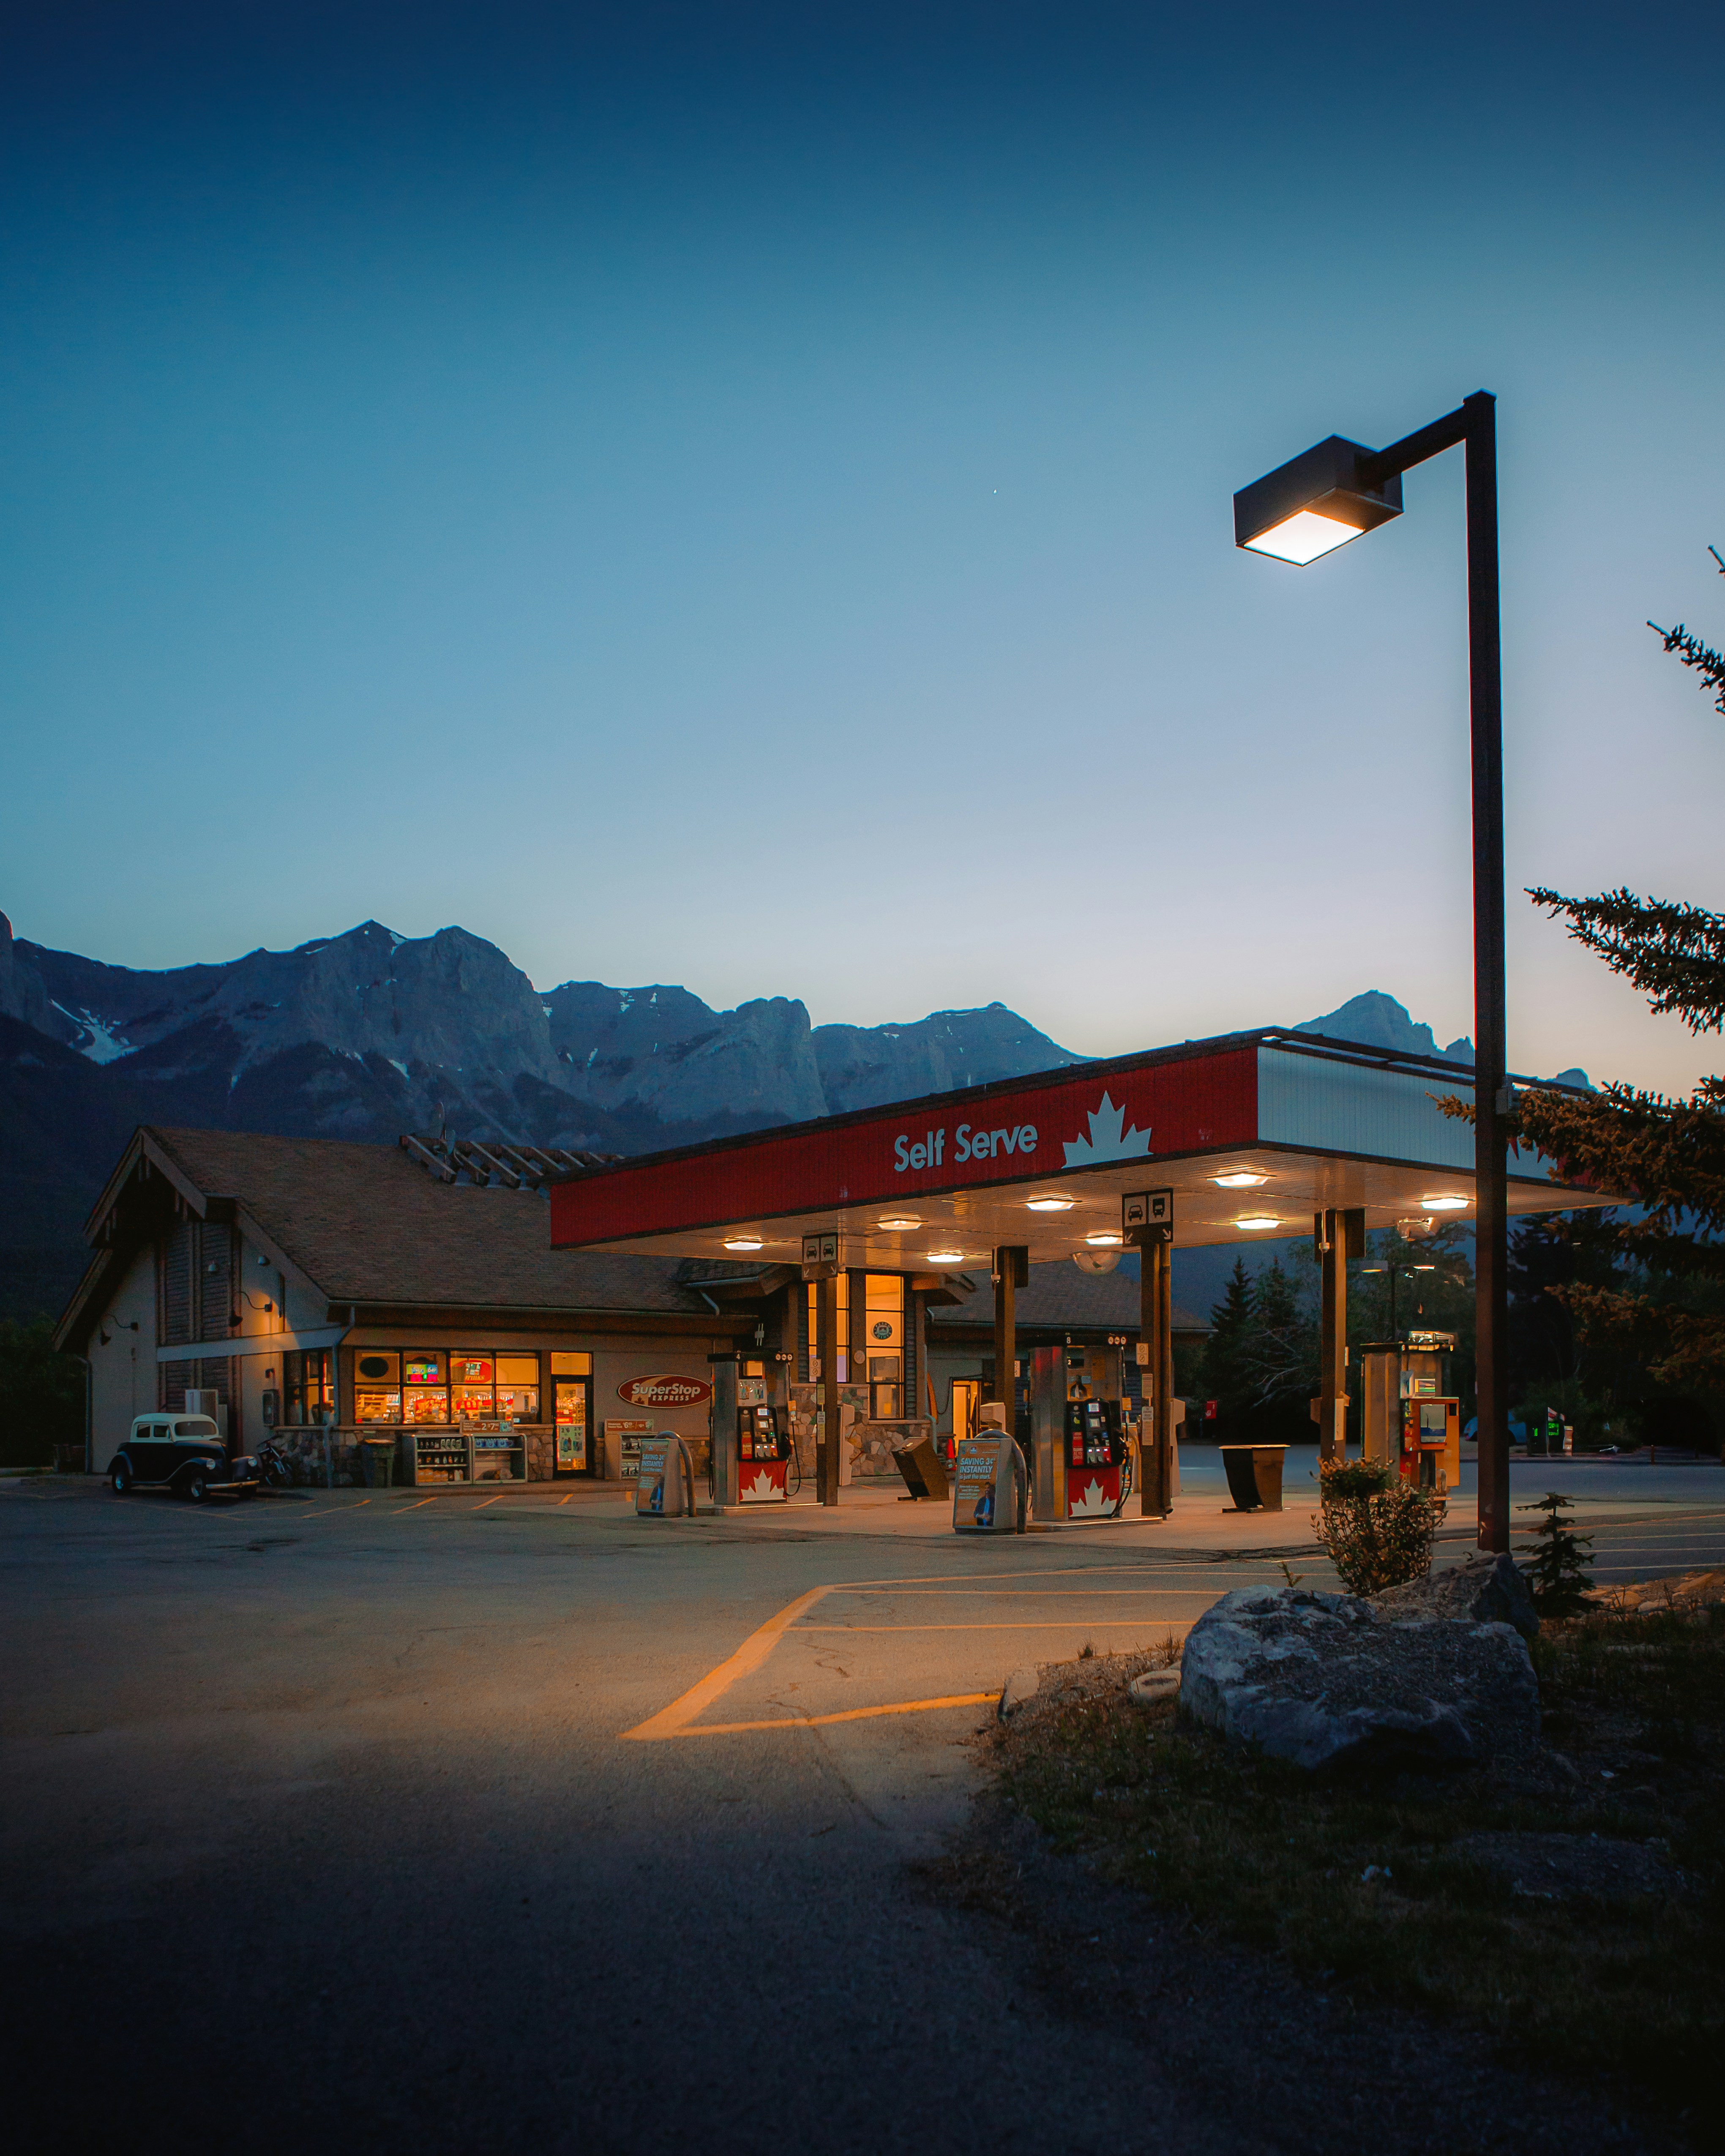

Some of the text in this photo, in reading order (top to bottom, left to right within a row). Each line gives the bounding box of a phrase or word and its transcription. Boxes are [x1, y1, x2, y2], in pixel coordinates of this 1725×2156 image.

[894, 1124, 1038, 1172] Self Serve
[631, 1383, 701, 1397] SuperStop
